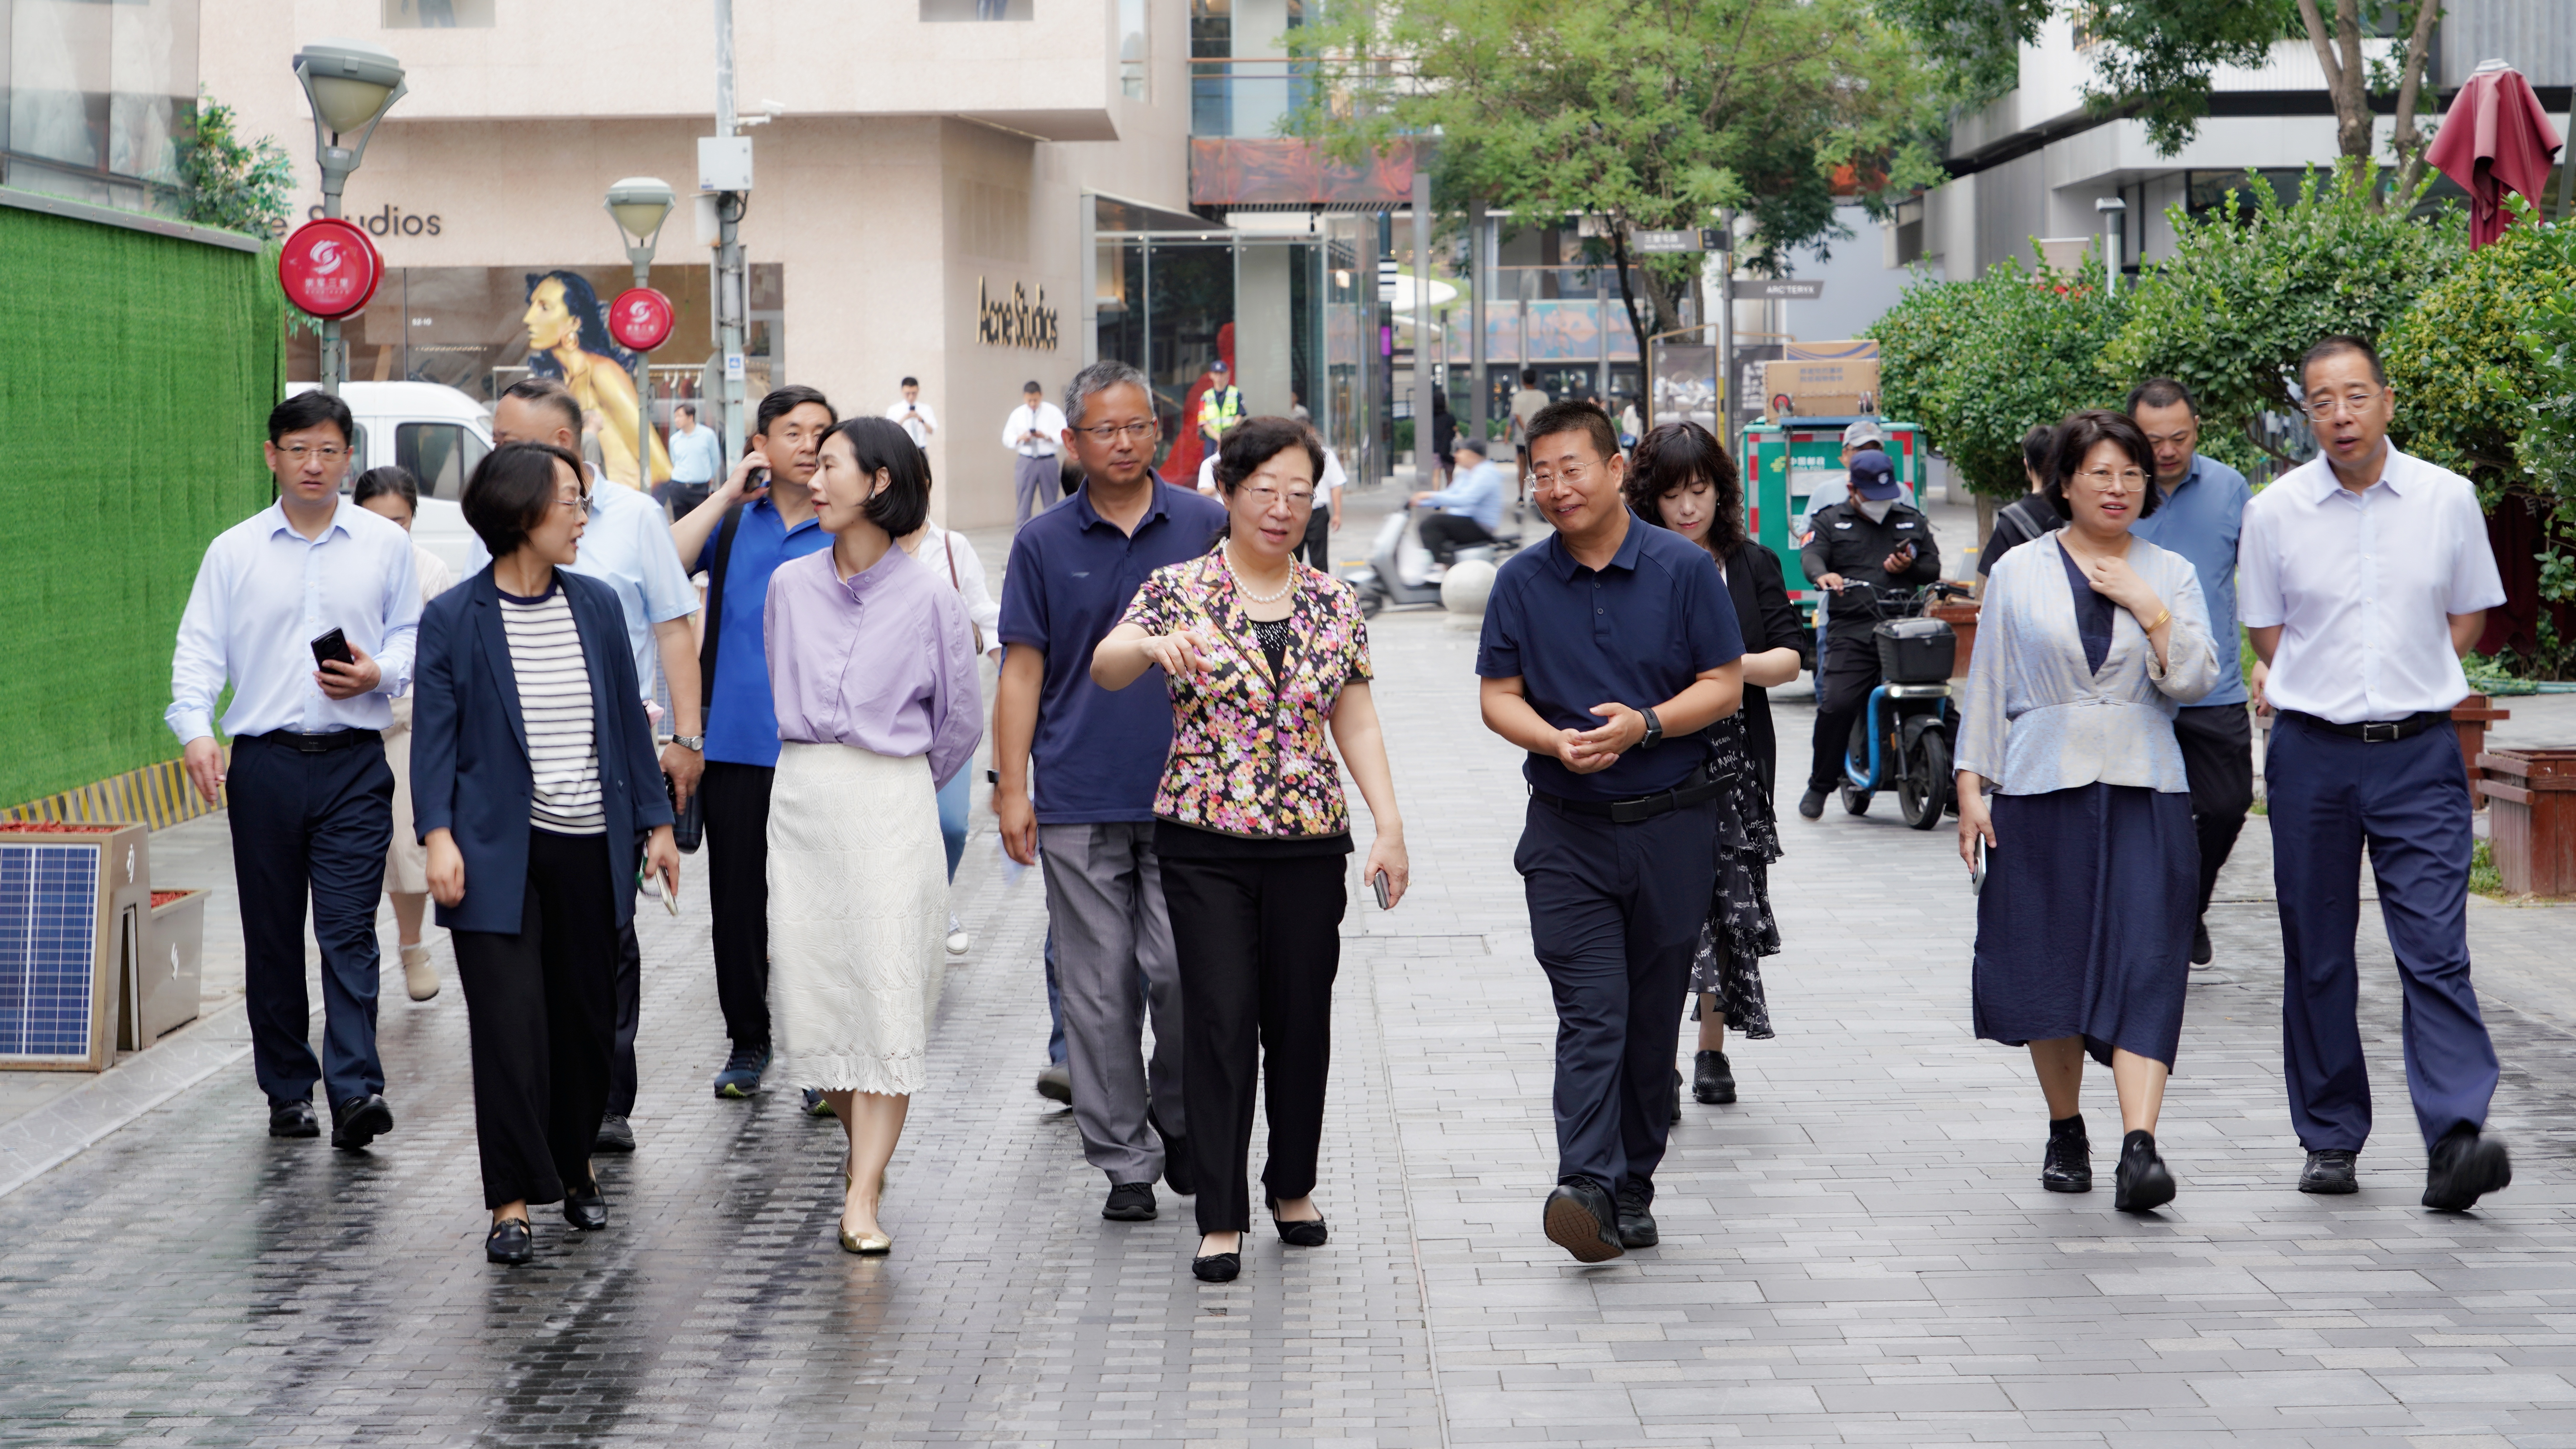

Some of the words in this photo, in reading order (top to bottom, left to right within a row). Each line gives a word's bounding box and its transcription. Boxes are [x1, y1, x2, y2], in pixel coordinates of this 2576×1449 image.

[976, 275, 1011, 346] Acne
[1012, 279, 1058, 350] Studios
[1711, 735, 1731, 747] dream
[1717, 750, 1737, 769] Magic
[1743, 1013, 1762, 1031] agic
